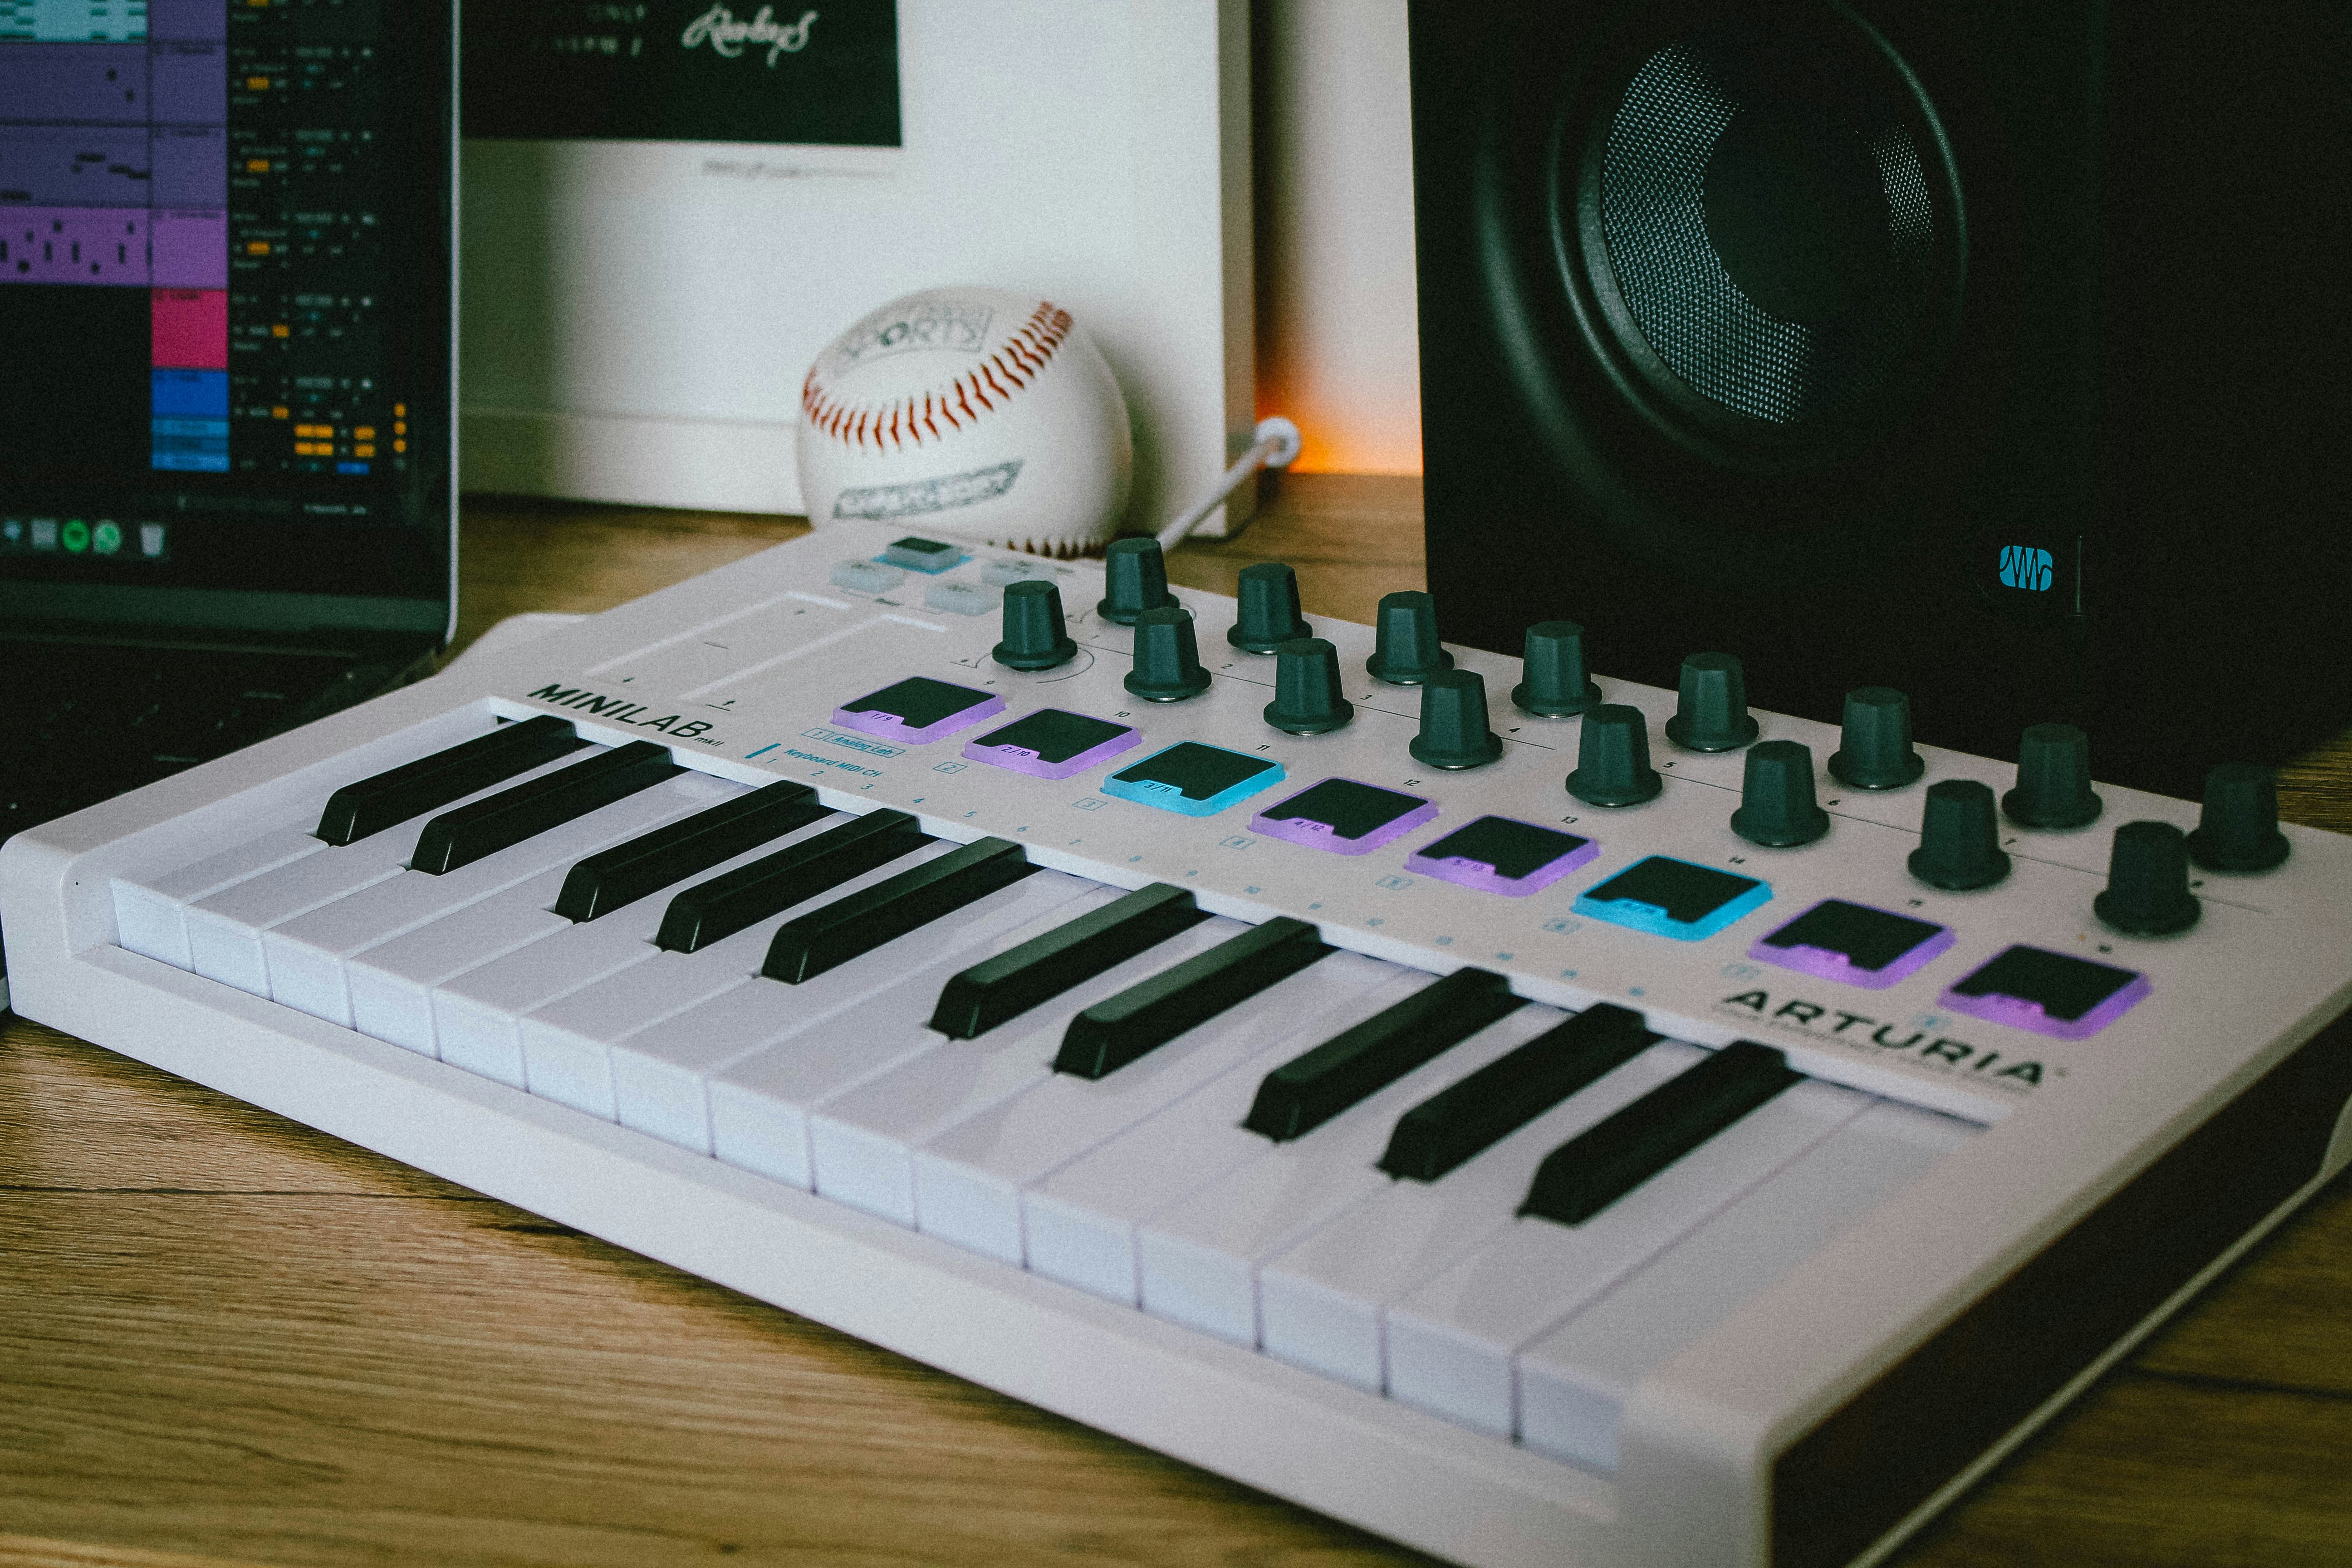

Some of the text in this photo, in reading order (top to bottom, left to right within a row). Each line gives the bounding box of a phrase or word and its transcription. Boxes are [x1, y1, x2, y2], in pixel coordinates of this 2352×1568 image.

[526, 683, 725, 747] MINILAB mkII
[871, 713, 893, 721] 1/9
[832, 736, 872, 750] Analog
[870, 746, 893, 755] Lab
[1001, 746, 1030, 757] 2/10
[784, 749, 839, 766] Keyboard
[835, 762, 865, 773] MIDI
[1144, 783, 1173, 793] 3/11
[1295, 821, 1325, 832] 4/12
[1725, 990, 2044, 1087] ARTURIA
